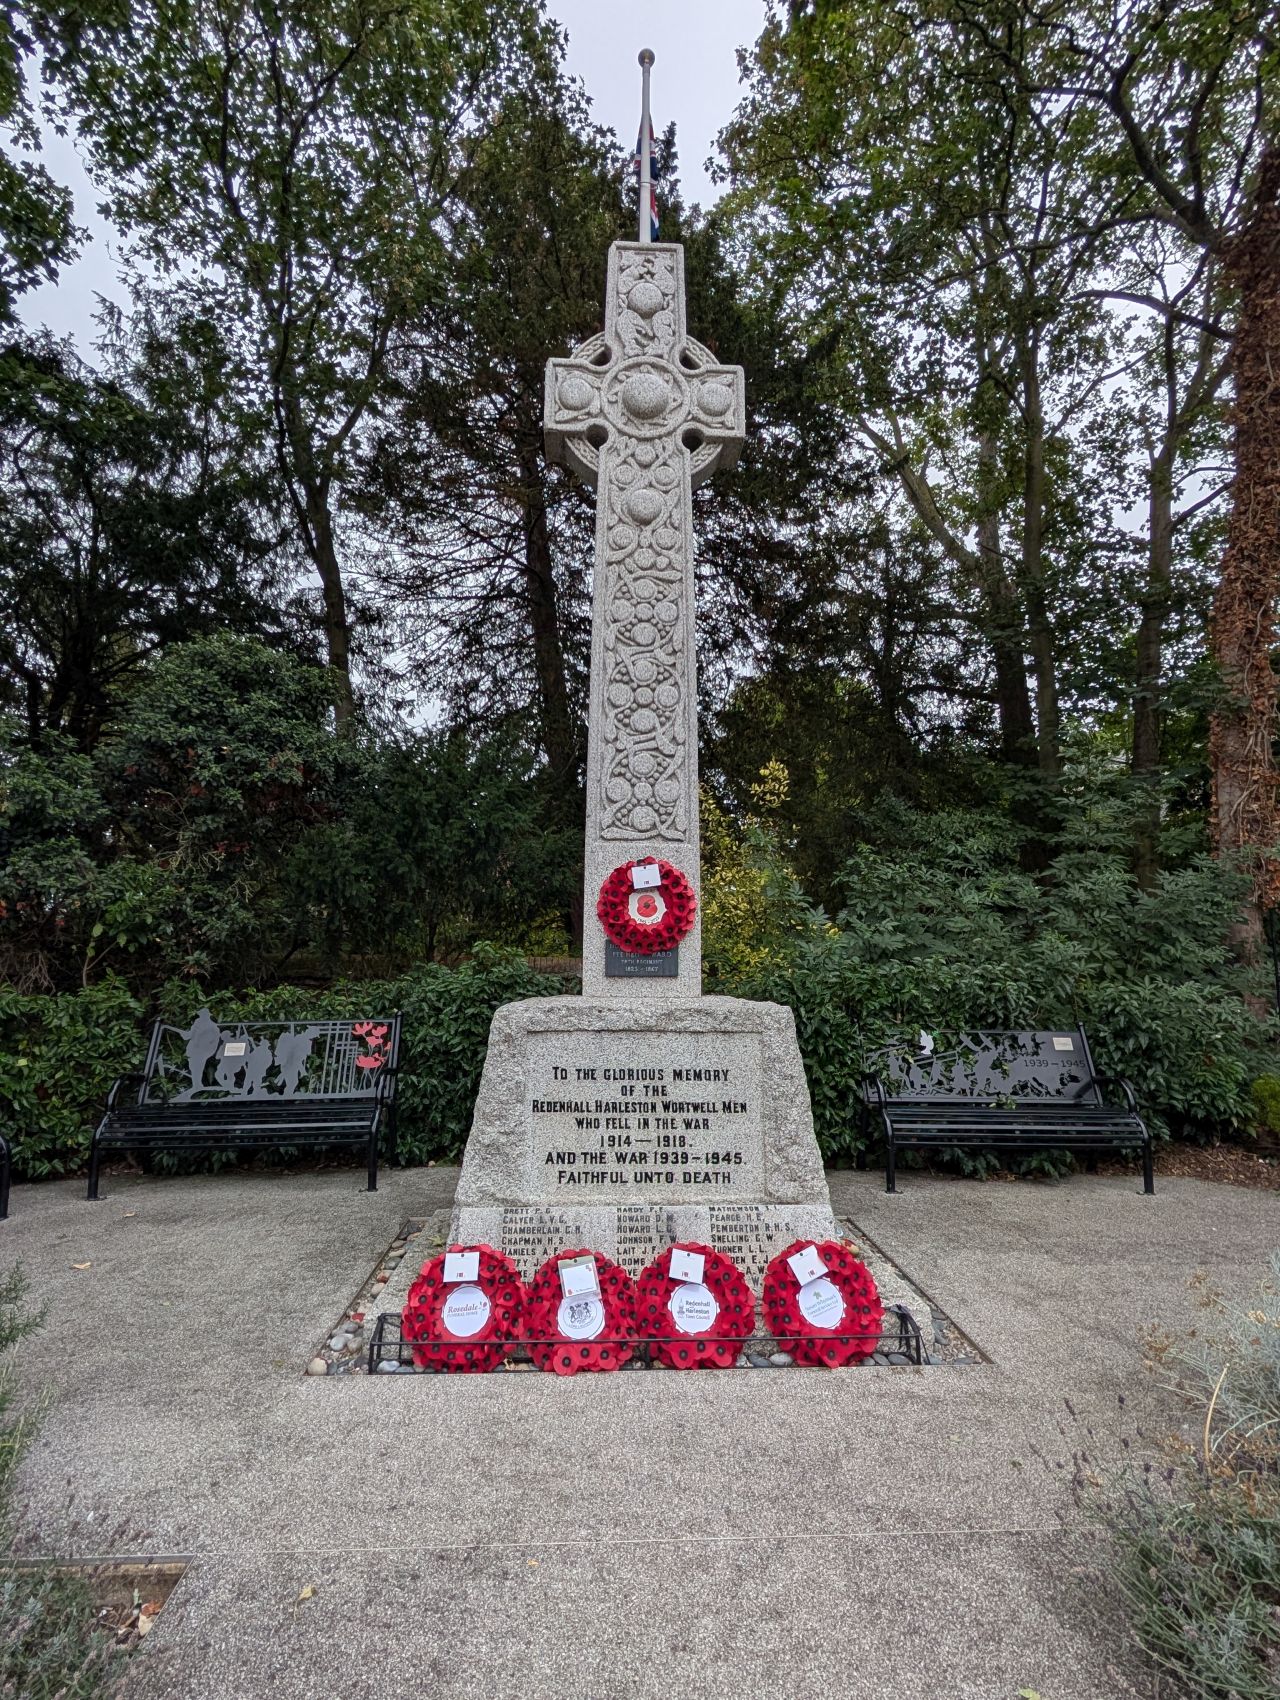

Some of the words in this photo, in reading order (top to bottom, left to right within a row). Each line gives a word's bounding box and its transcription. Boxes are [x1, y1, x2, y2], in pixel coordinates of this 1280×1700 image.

[552, 1066, 568, 1080] TO
[575, 1068, 597, 1081] THE
[603, 1068, 664, 1081] GLORIOUS
[673, 1069, 730, 1082] MEMORY
[621, 1085, 635, 1097] OF
[643, 1085, 668, 1097] THE
[532, 1100, 592, 1113] REDENHALL
[595, 1100, 657, 1113] HARLESTON
[661, 1100, 719, 1114] WORTWELL
[722, 1101, 748, 1114] MEN
[575, 1117, 600, 1129] WHO
[605, 1117, 631, 1130] FELL
[638, 1117, 650, 1130] IN
[655, 1117, 678, 1130] THE
[682, 1117, 710, 1130] WAR
[545, 1151, 577, 1165] AND
[580, 1151, 607, 1165] THE
[615, 1151, 649, 1165] WAR
[558, 1170, 629, 1184] FAITHFUL
[633, 1171, 674, 1184] UNTO
[502, 1215, 535, 1225] CALVER
[616, 1214, 651, 1223] HOWARD
[709, 1213, 741, 1222] PEARCE
[502, 1226, 560, 1235] CHAMBERLAIN
[616, 1225, 651, 1234] HOWARD
[710, 1223, 760, 1233] PEMBERTON
[501, 1236, 543, 1246] CHAPMAN
[617, 1236, 653, 1245] JOHNSON
[711, 1233, 750, 1243] SNELLING
[501, 1247, 537, 1256] DANIELS
[616, 1246, 636, 1256] LAIT
[712, 1245, 744, 1254] TURNER
[685, 1299, 711, 1307] Redenhall
[448, 1303, 479, 1314] Rosedale
[685, 1307, 710, 1315] Harleston
